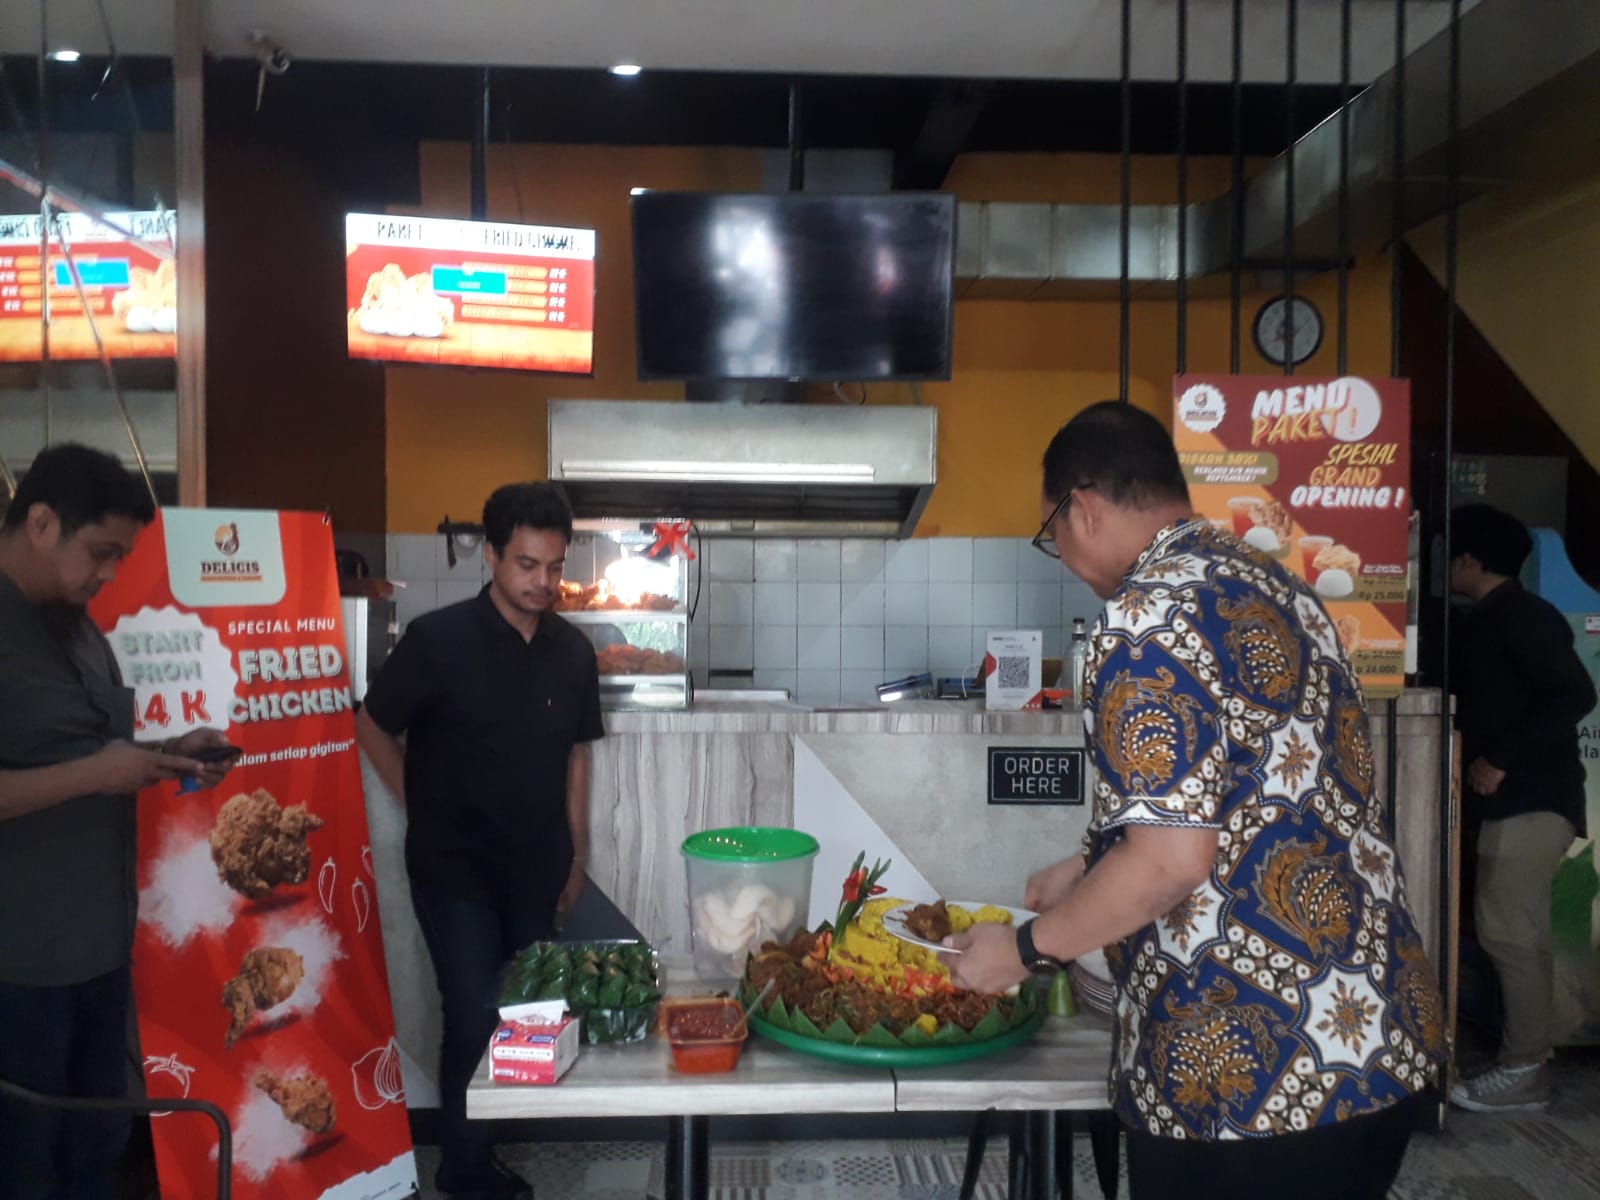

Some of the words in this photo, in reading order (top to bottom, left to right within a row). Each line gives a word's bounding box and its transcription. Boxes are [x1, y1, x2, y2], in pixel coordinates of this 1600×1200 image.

[1251, 383, 1349, 418] MENU
[1251, 408, 1340, 447] PAKET
[1323, 442, 1399, 467] SPESIAL
[1308, 466, 1382, 488] GRAND
[1289, 486, 1392, 508] OPENING
[200, 560, 260, 574] DELICIS
[228, 619, 291, 635] SPECIAL
[297, 618, 336, 630] MENU
[119, 630, 204, 654] START
[129, 661, 203, 682] FROM
[238, 645, 343, 684] FRIED
[181, 690, 211, 724] K
[227, 687, 352, 724] CHICKEN
[270, 746, 308, 761] setiap
[1004, 757, 1070, 774] ORDER
[1012, 776, 1062, 794] HERE
